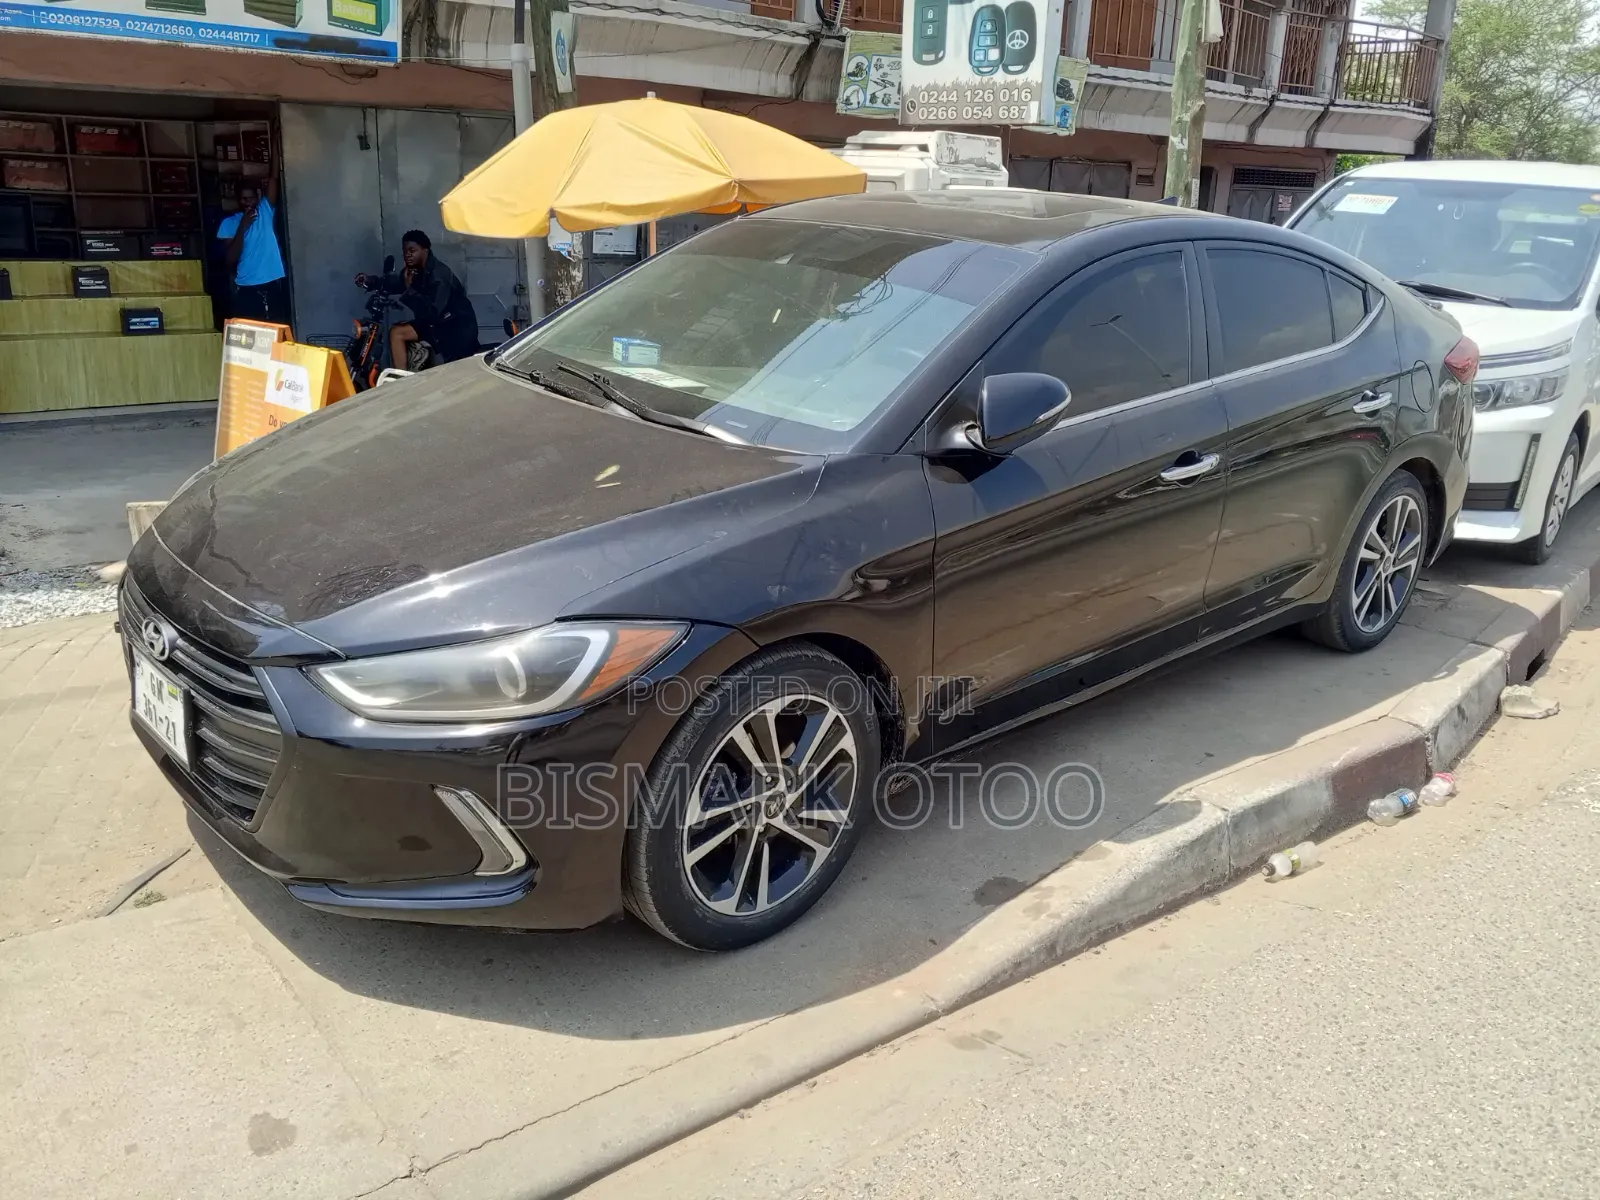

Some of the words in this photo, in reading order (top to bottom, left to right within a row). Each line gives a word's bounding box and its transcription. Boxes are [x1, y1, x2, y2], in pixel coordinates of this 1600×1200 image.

[126, 20, 196, 39] 0274712660,
[198, 27, 261, 43] 0244481717
[920, 90, 958, 104] 0244
[964, 89, 995, 103] 126
[1000, 87, 1032, 102] 016
[918, 105, 957, 120] 0266
[962, 104, 993, 119] 054
[998, 104, 1028, 119] 687
